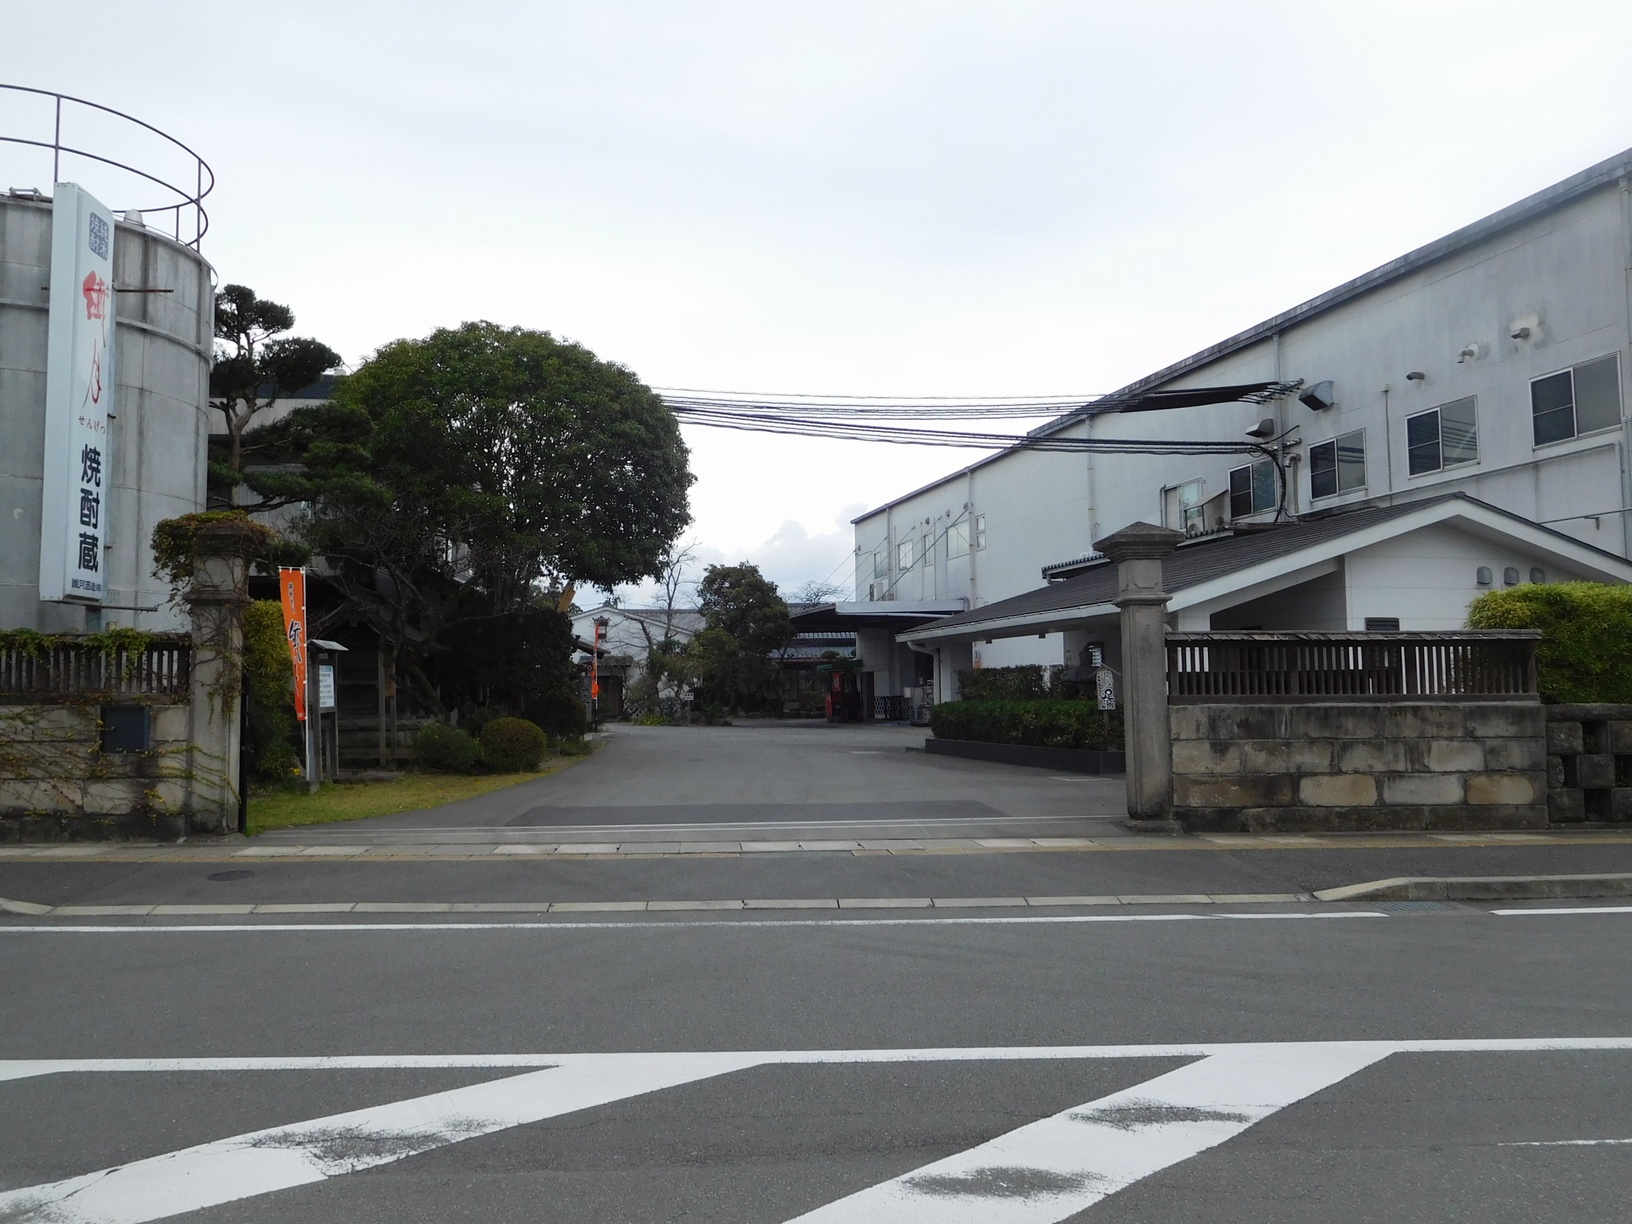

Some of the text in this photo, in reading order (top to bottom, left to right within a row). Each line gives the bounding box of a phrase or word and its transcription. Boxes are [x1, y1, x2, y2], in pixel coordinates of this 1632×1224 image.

[78, 415, 106, 434] せんげつ
[78, 443, 101, 573] 焼酎蔵
